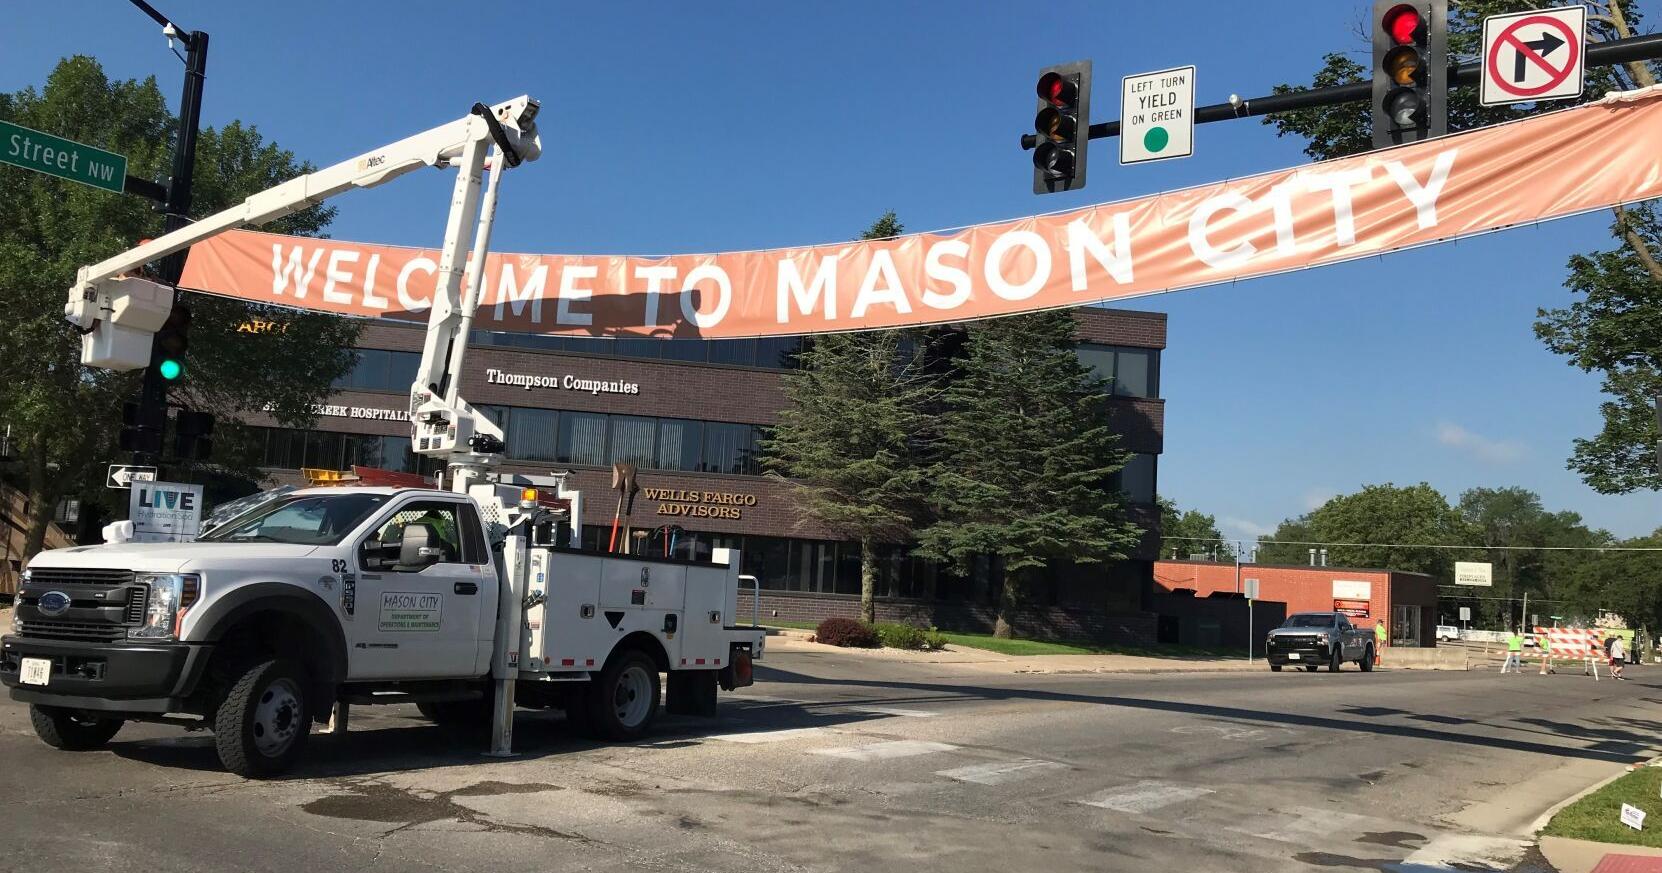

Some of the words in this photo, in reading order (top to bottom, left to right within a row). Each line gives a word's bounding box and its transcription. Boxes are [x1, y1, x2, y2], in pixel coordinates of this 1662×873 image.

[1131, 81, 1153, 93] LEFT
[1161, 76, 1185, 88] TURN
[1139, 92, 1177, 109] YIELD
[1132, 114, 1145, 125] ON
[1151, 109, 1182, 122] GREEN
[8, 134, 79, 172] Street
[88, 160, 114, 182] NW
[271, 243, 598, 326] WELCME
[634, 264, 733, 328] TO
[776, 211, 1135, 324] MASON
[1188, 149, 1459, 271] CITY
[486, 368, 558, 389] Thompson
[563, 374, 639, 395] Companies
[123, 472, 134, 481] ONE
[138, 473, 151, 481] WAY
[139, 489, 194, 510] LIVE
[644, 488, 699, 502] WELLS
[703, 491, 757, 506] FARGO
[656, 503, 741, 519] ADVISORS
[331, 559, 347, 573] 82
[384, 595, 417, 608] MASON
[419, 596, 439, 609] CITY
